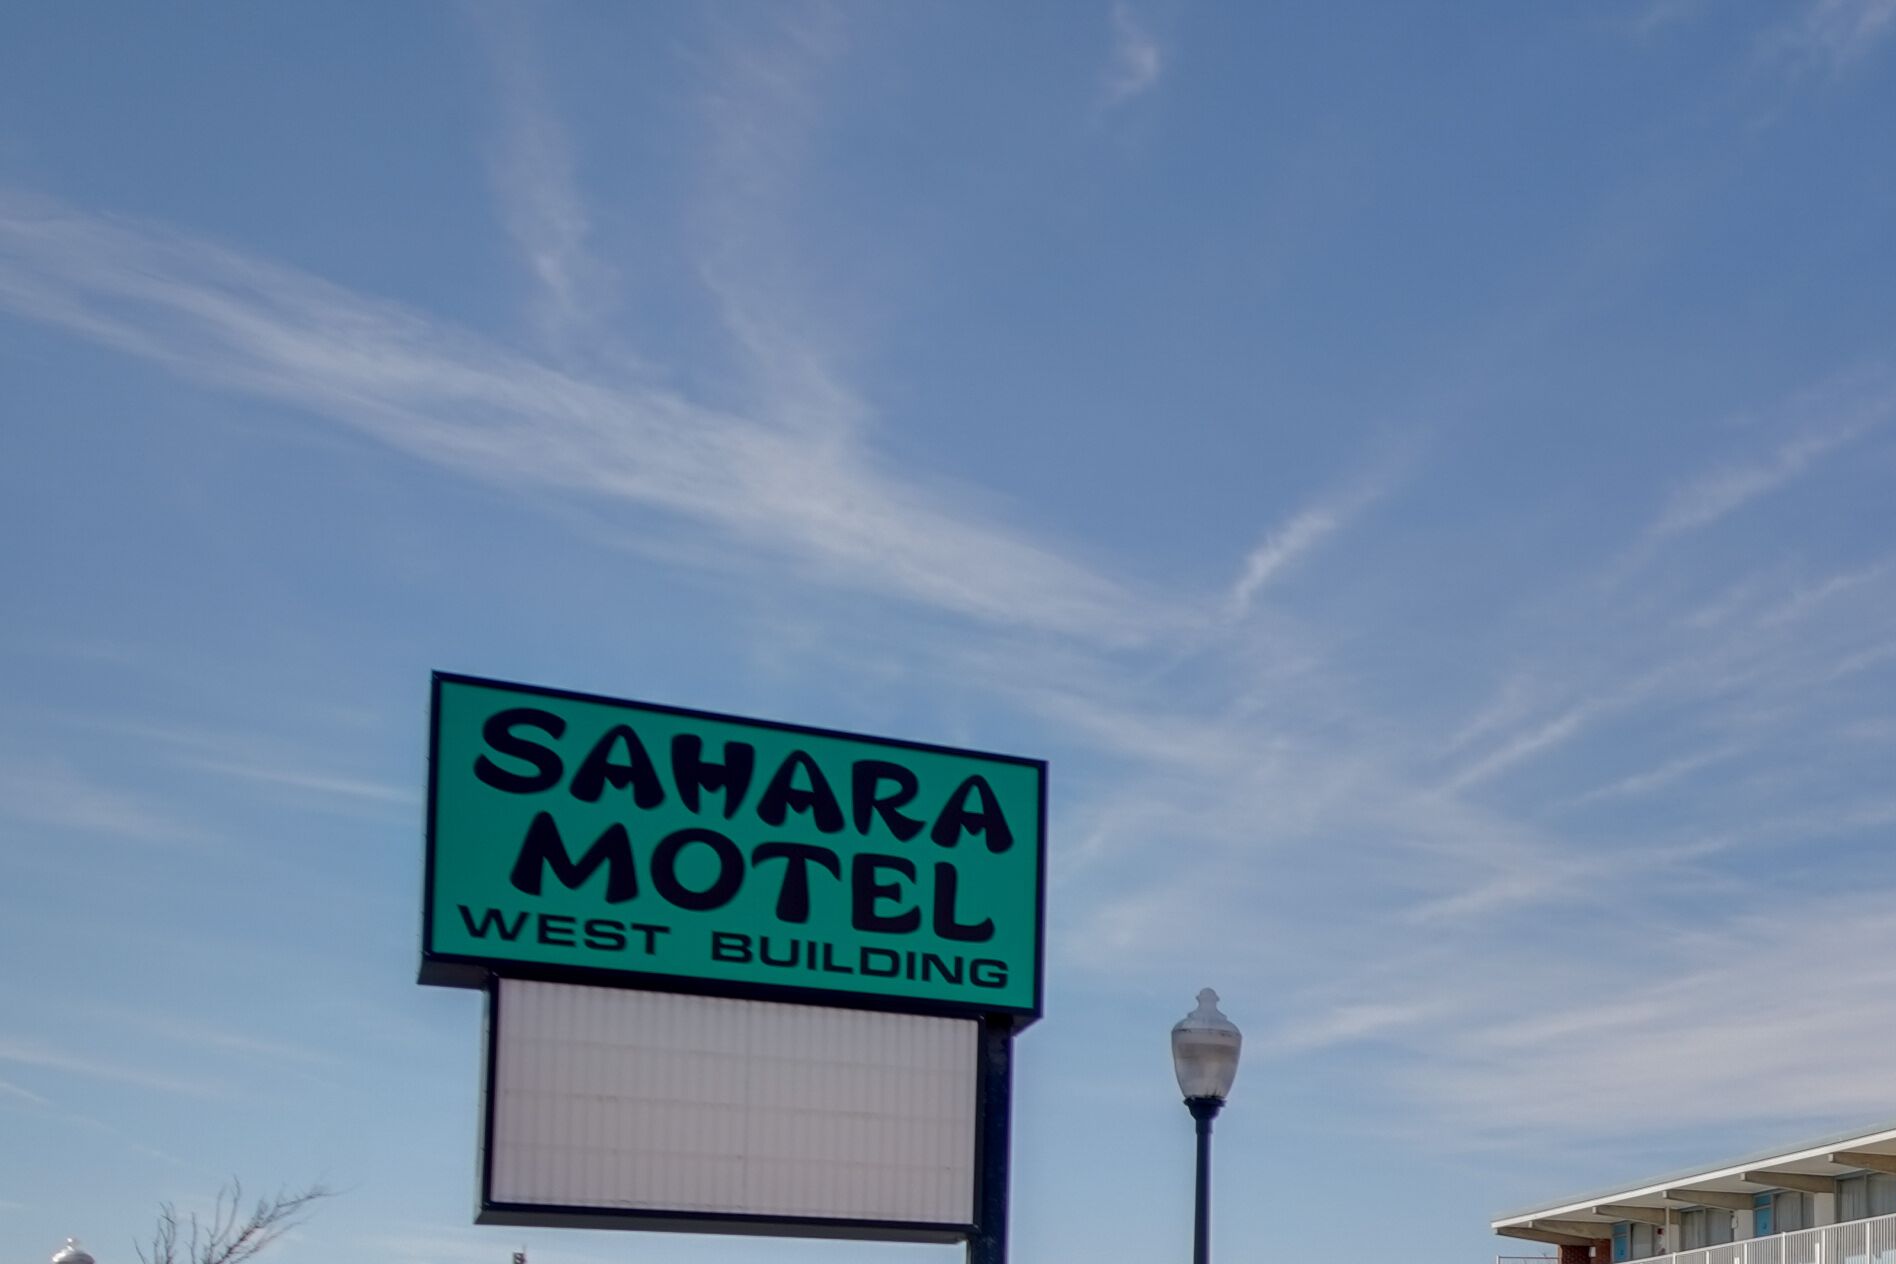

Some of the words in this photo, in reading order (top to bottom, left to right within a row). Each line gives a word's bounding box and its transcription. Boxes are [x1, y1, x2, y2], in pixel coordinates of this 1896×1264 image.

[473, 708, 1014, 854] SAHARA
[510, 810, 995, 942] MOTEL
[457, 904, 670, 955] WEST
[711, 931, 1009, 988] BUILDING
